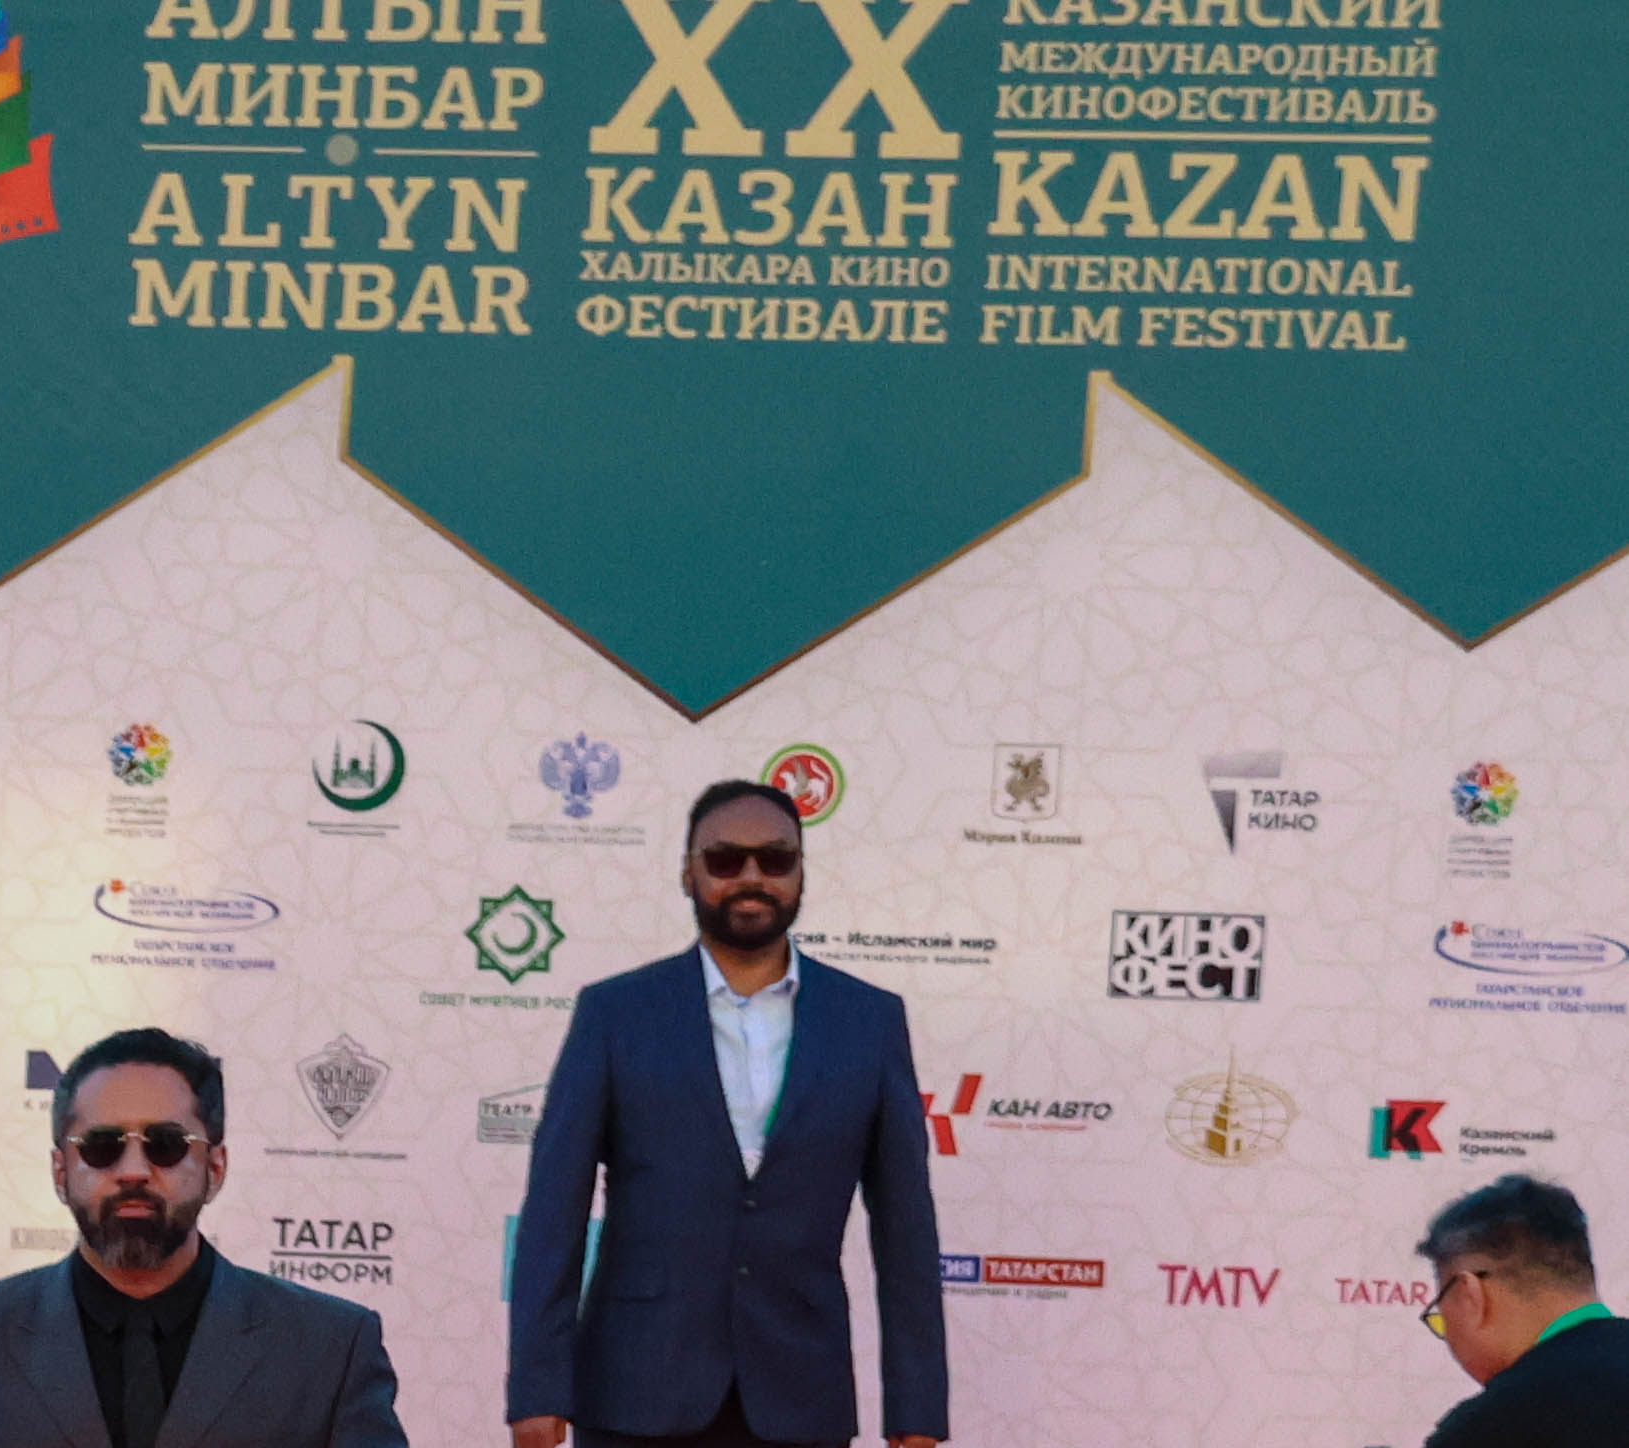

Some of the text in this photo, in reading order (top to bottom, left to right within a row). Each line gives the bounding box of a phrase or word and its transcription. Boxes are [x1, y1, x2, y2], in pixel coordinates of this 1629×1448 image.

[145, 0, 546, 44] АЛТЫН
[999, 38, 1438, 81] МЕЖДУНАРОДНЫЙ
[141, 62, 544, 131] МИНБАР
[995, 85, 1437, 123] КИНОФЕСТИВАЛЬ
[128, 172, 528, 252] ALTYN
[582, 167, 954, 248] КАЗАН
[988, 150, 1430, 242] KAZAN
[579, 250, 950, 288] ХАЛЫКАРА КИНО
[984, 254, 1412, 298] INTERNATIONAL
[128, 259, 532, 335] MINBAR
[576, 294, 948, 343] ФЕСТИВАЛЕ
[979, 305, 1407, 351] FILM FESTIVAL
[1249, 788, 1320, 809] ТАТАР
[1247, 811, 1319, 832] КИНО
[1113, 913, 1265, 958] КИНО
[1110, 958, 1263, 999] ФЕСТ
[988, 1098, 1112, 1121] КАН АВТО
[1459, 1124, 1555, 1144] Казанский
[271, 1216, 395, 1252] ТАТАР
[267, 1260, 394, 1286] ИНФОРМ
[989, 1260, 1099, 1282] ТАТАРСТАН
[1159, 1264, 1280, 1309] TMTV
